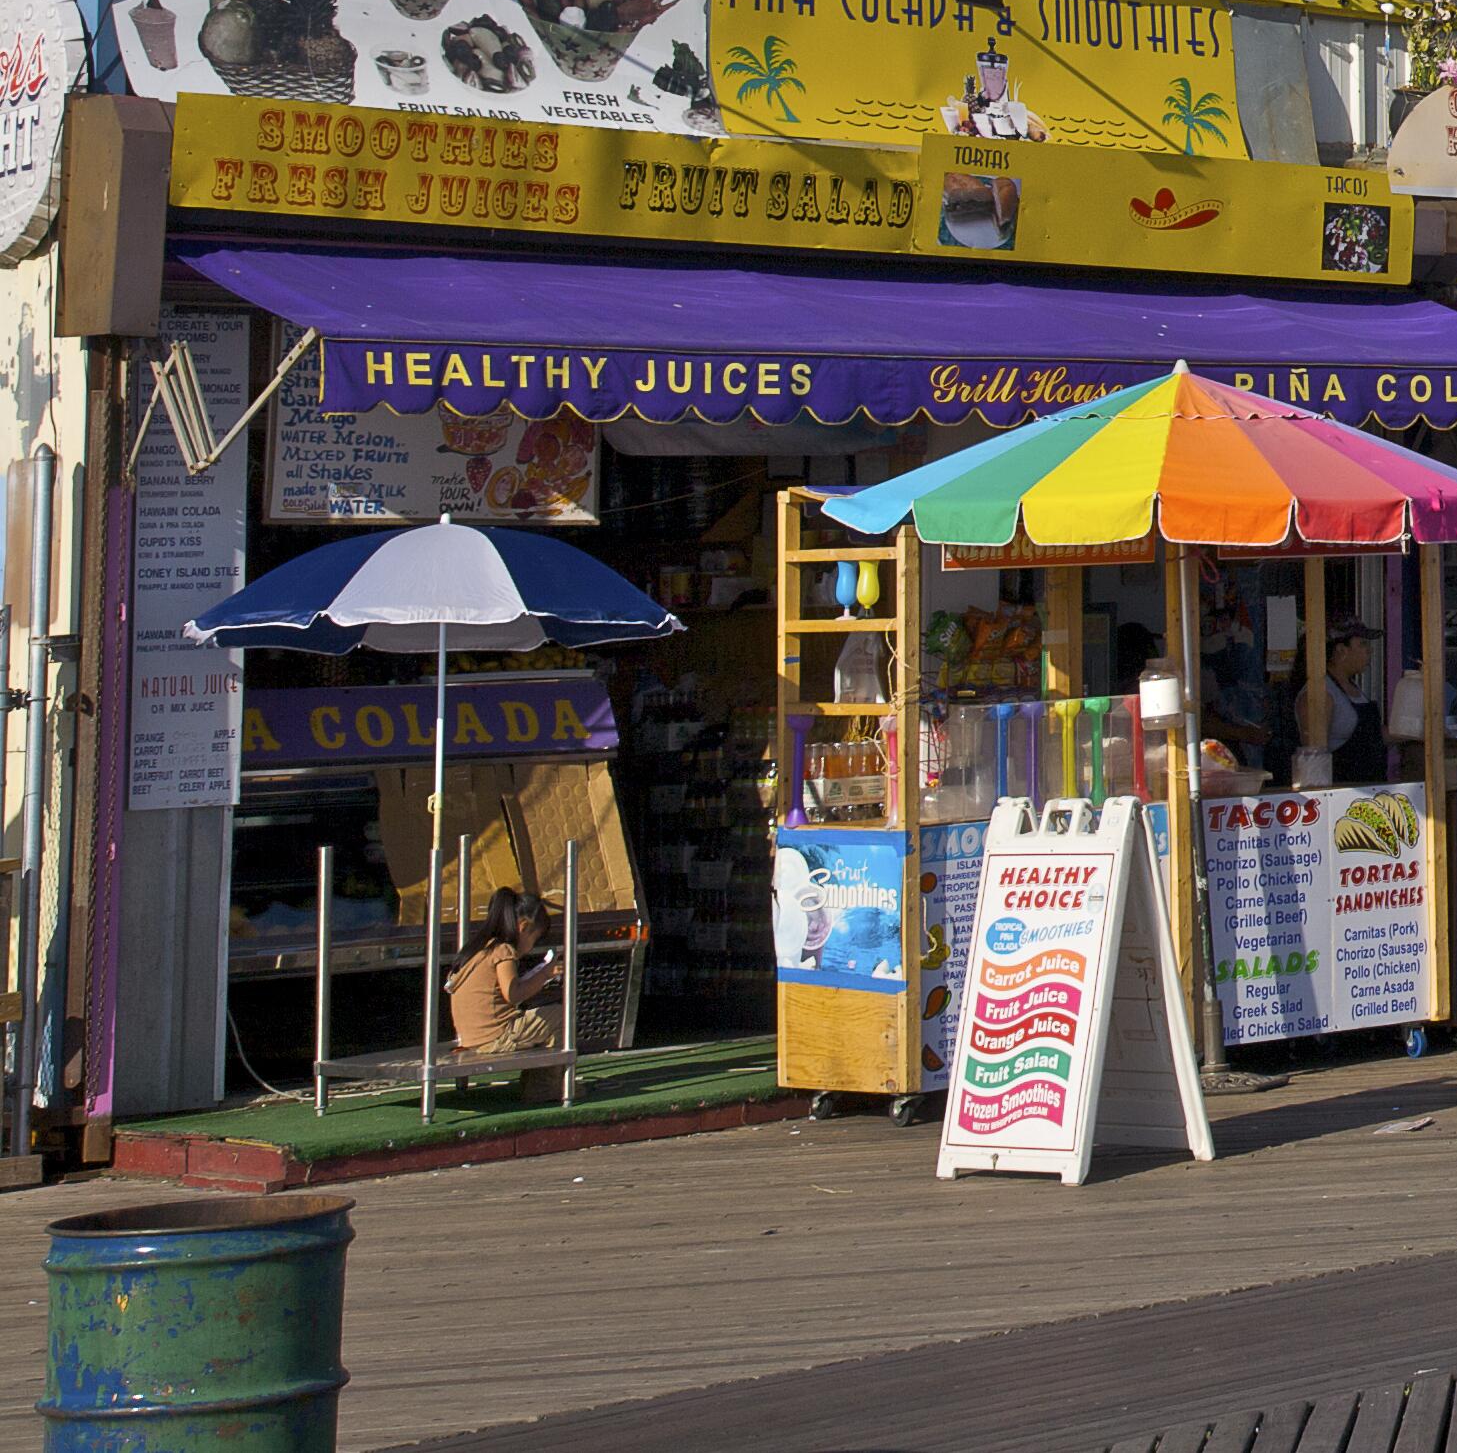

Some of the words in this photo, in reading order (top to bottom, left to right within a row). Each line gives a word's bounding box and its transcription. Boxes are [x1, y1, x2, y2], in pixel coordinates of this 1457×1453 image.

[561, 90, 621, 108] FRESH
[540, 103, 654, 126] VEGETABLES
[257, 108, 560, 172] SMOOTHIES
[953, 145, 1011, 170] TORTAS
[211, 156, 388, 212] FRESH
[405, 172, 581, 226] JUICES
[617, 158, 759, 220] FRUIT
[765, 169, 915, 228] SALAD
[1325, 175, 1369, 198] TACOS
[365, 349, 609, 392] HEALTHY
[635, 358, 809, 397] JUICES
[930, 365, 1018, 405] Grill
[1235, 366, 1346, 403] PIÑA
[281, 448, 345, 462] MIXED
[139, 476, 180, 486] BANANA
[184, 476, 215, 485] BERRY
[138, 568, 171, 579] CONEY
[176, 567, 210, 577] ISLAND
[214, 567, 240, 577] STILE
[202, 674, 238, 694] JUICE
[1208, 798, 1320, 832] TACOS
[1217, 837, 1270, 852] Carnitas
[1274, 832, 1311, 850] (Pork)
[832, 858, 869, 882] fruit
[1208, 857, 1257, 872] Chorizo
[1260, 851, 1322, 867] (Sausage)
[1340, 860, 1420, 888] TORTAS
[999, 866, 1098, 886] HEALTHY
[1217, 877, 1250, 891] Pollo
[1254, 871, 1313, 888] (Chicken)
[797, 867, 897, 912] Smoothies
[1004, 890, 1085, 910] CHOICE
[1336, 886, 1425, 915] SANDWICHES
[1019, 920, 1093, 946] SMOOTHIES
[985, 965, 1032, 987] Carrot
[1034, 955, 1080, 977] Juice
[1216, 950, 1320, 983] SALADS
[985, 998, 1020, 1019] Fruit
[1022, 988, 1068, 1008] Juice
[1246, 982, 1290, 1001] Regular
[1233, 1003, 1267, 1020] Greek
[1271, 1000, 1302, 1014] Salad
[974, 1023, 1024, 1051] Orange
[1027, 1019, 1071, 1038] Juice
[974, 1063, 1009, 1084] Fruit
[1013, 1054, 1059, 1074] Salad
[963, 1094, 999, 1120] Frozen
[1001, 1083, 1061, 1113] Smoothies
